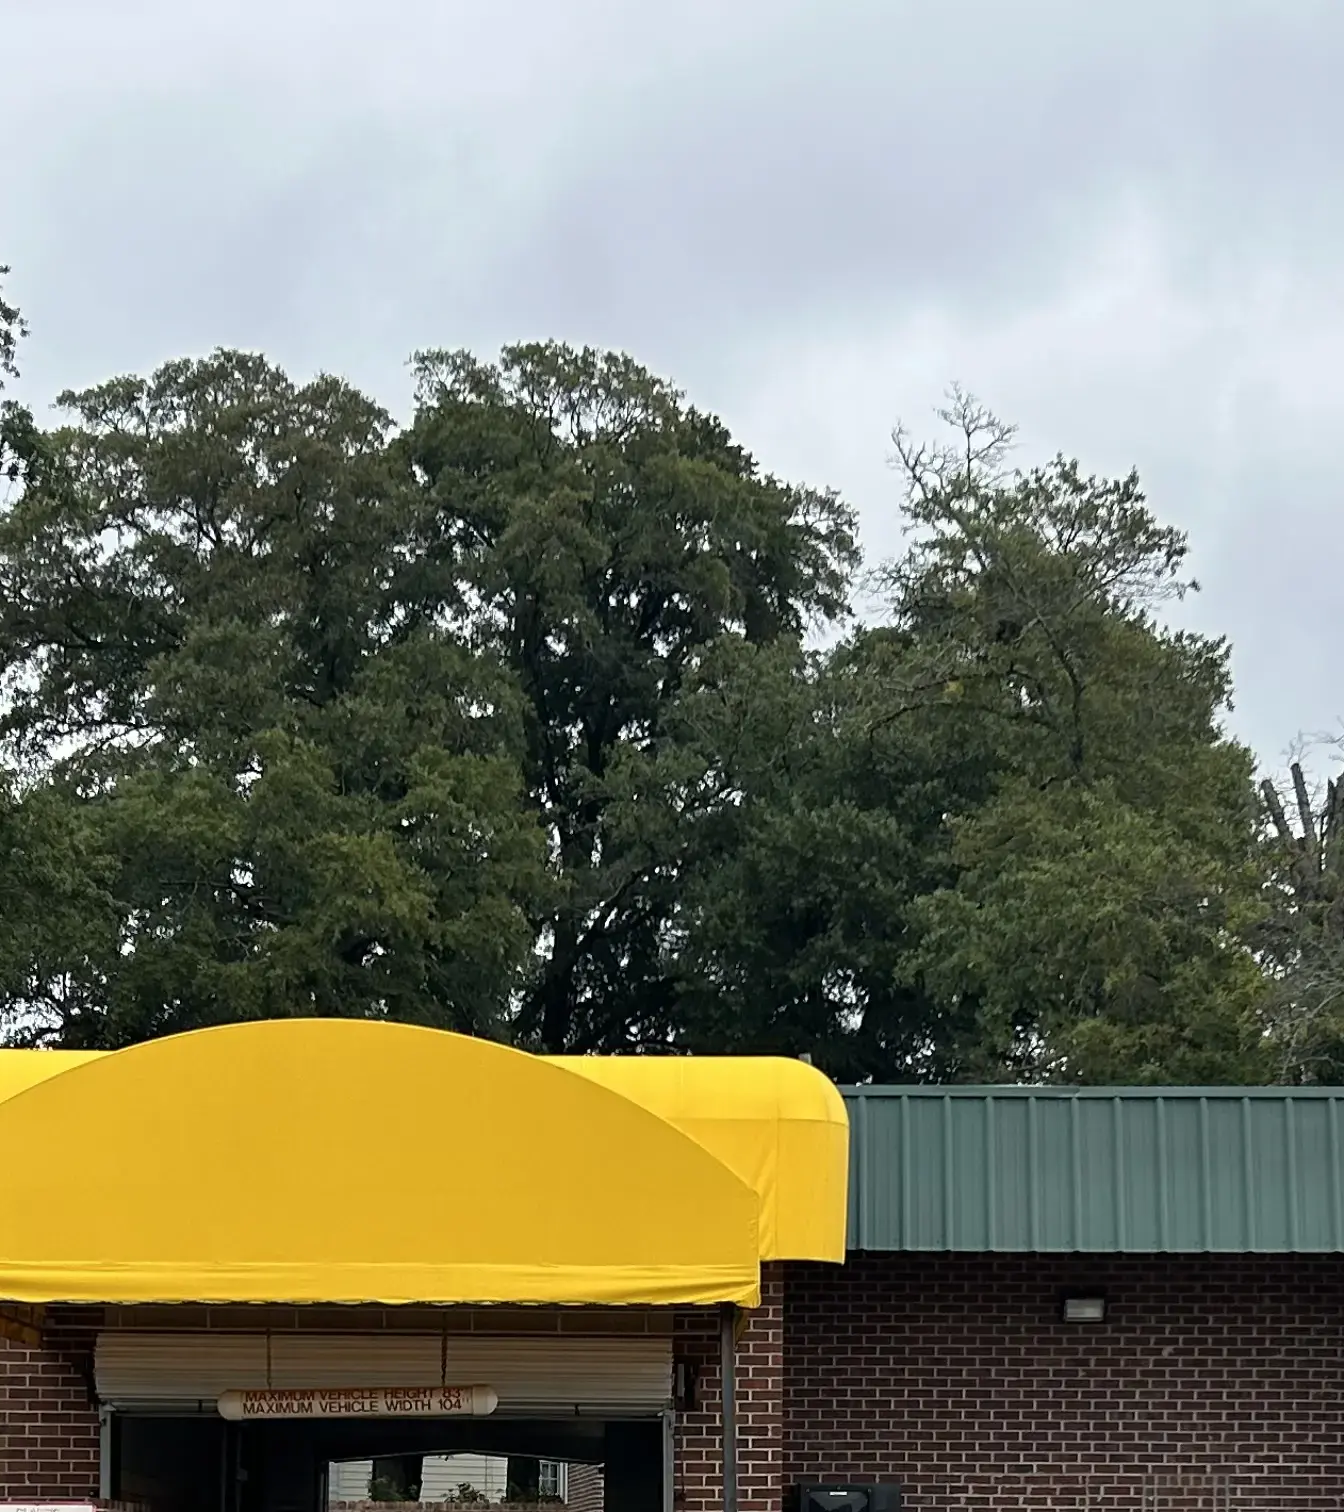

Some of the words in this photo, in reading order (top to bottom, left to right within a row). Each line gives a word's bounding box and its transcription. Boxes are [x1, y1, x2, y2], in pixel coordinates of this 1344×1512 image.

[245, 1390, 315, 1402] MAXIMUM
[319, 1389, 379, 1400] VEHICLE
[384, 1387, 433, 1399] HEIGHT
[243, 1402, 313, 1414] MAXIMUM
[319, 1401, 379, 1413] VEHICLE
[385, 1399, 431, 1411] WIDTH
